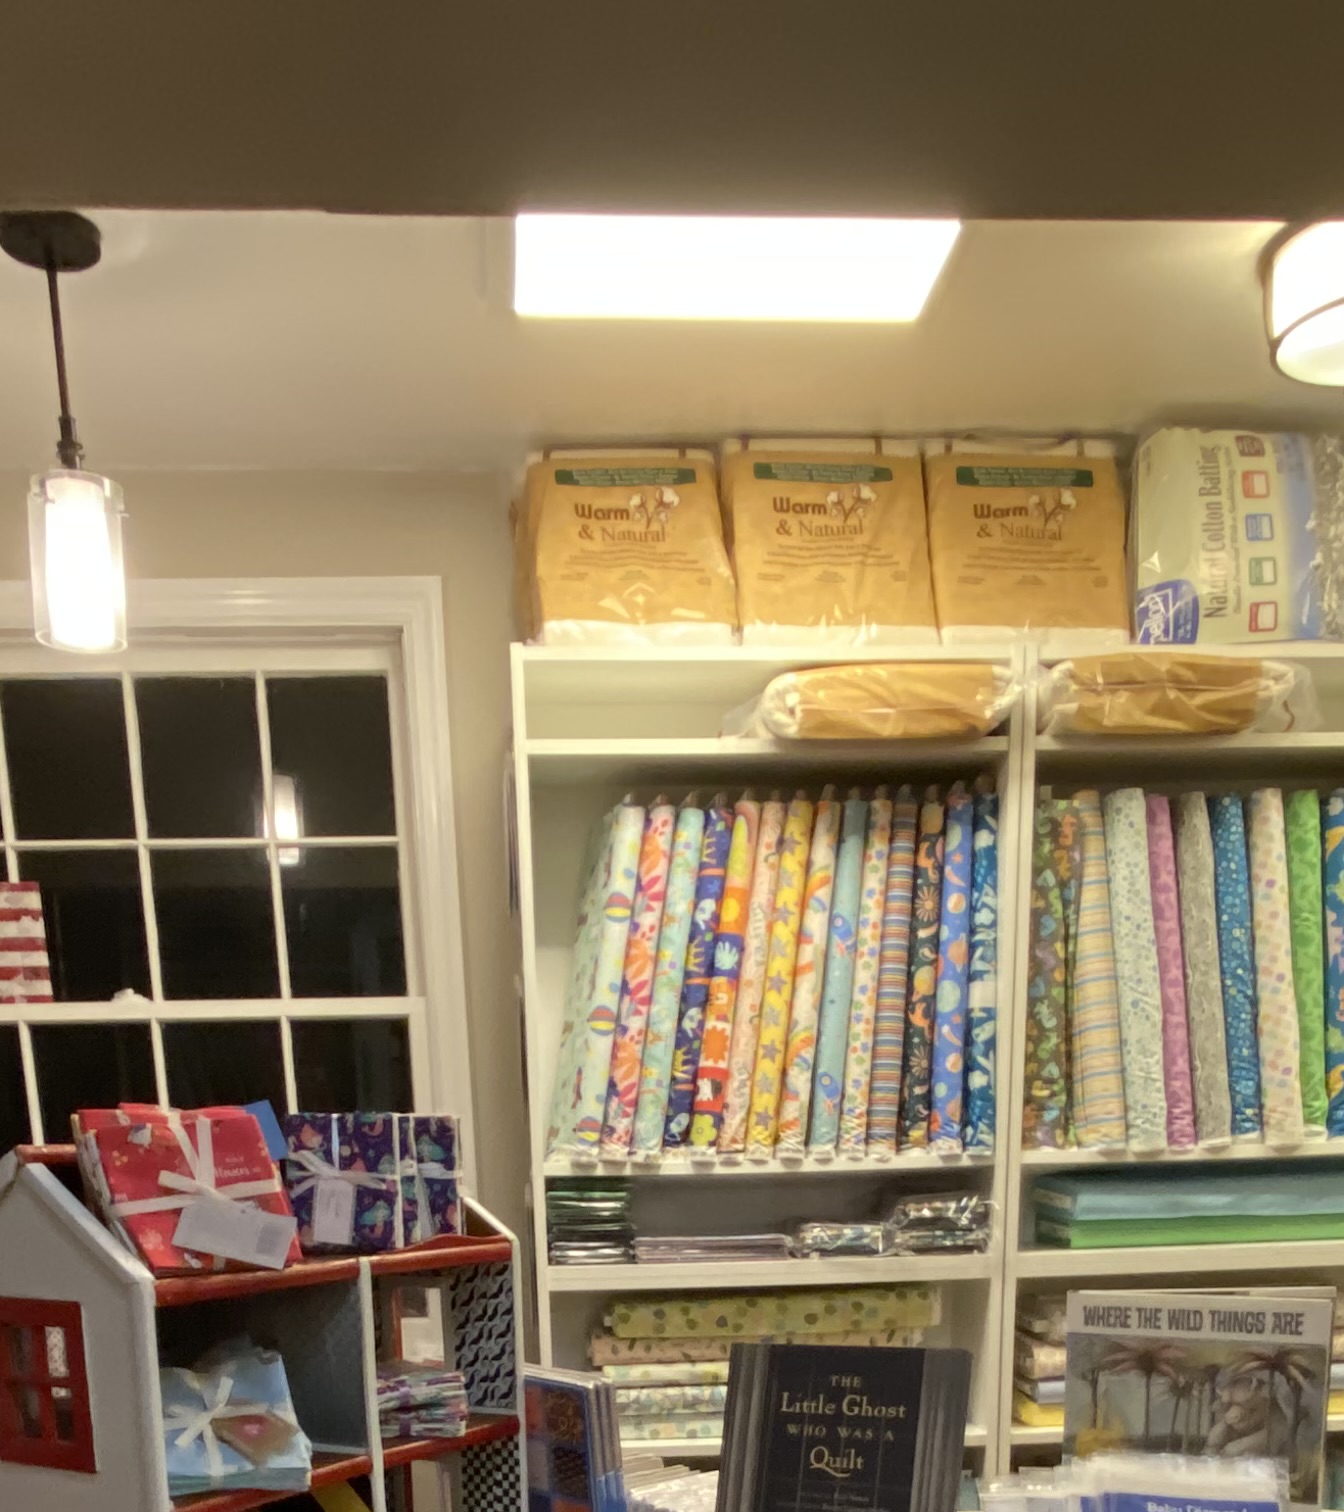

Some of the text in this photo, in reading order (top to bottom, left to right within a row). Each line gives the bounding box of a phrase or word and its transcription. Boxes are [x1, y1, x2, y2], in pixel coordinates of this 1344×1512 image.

[574, 503, 630, 521] Warm
[772, 497, 827, 515] Warm
[973, 503, 1029, 519] Warm
[578, 524, 666, 543] & Natural
[775, 519, 864, 537] & Natural
[976, 523, 1063, 541] & Natural
[1198, 444, 1228, 618] Natural Cotton Batting
[1083, 1305, 1305, 1336] WHERE THE WILD THINGS ARE
[831, 1375, 862, 1388] THE
[780, 1391, 907, 1418] Little Ghost
[786, 1423, 895, 1442] WHO WAS A
[809, 1446, 864, 1478] Quilt
